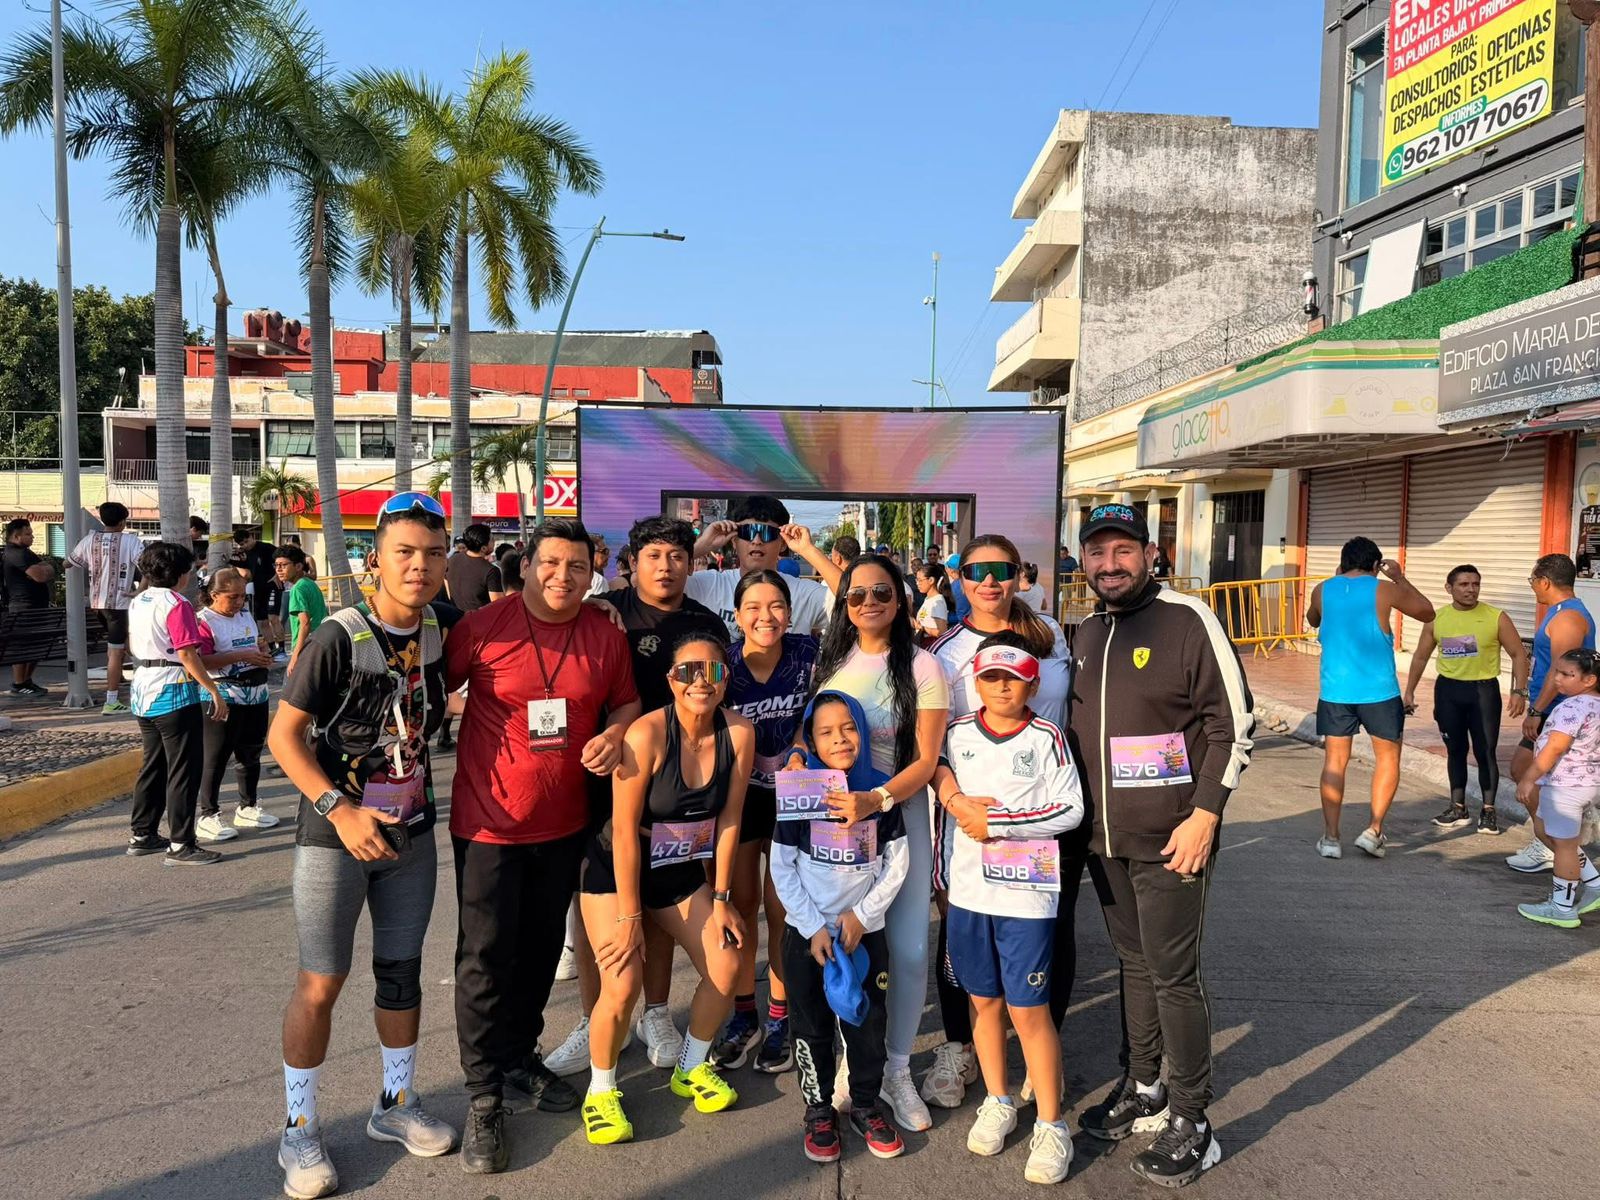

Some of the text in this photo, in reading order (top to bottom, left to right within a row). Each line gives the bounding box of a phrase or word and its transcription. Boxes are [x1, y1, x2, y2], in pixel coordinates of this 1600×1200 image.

[1394, 4, 1449, 52] LOCALES
[1395, 0, 1430, 28] EN
[1394, 55, 1405, 71] EN
[1406, 33, 1440, 65] PLANTA
[1442, 22, 1467, 43] BAJA
[1470, 11, 1476, 27] Y
[1451, 34, 1478, 59] PARA:
[1391, 9, 1551, 112] CONSULTORIOS OFICINAS
[1393, 40, 1545, 135] DESPACHOS ESTÉTICAS
[1403, 85, 1543, 170] 962 107 7067
[1443, 99, 1483, 128] INFORMES
[1444, 339, 1507, 375] EDIFICIO
[1512, 321, 1569, 358] MARIA
[1470, 348, 1600, 395] PLAZA SAN FRANCI
[1113, 762, 1159, 778] 1576
[777, 795, 821, 811] 1507
[651, 840, 692, 858] 478
[811, 844, 855, 862] 1506
[982, 863, 1030, 880] 1508
